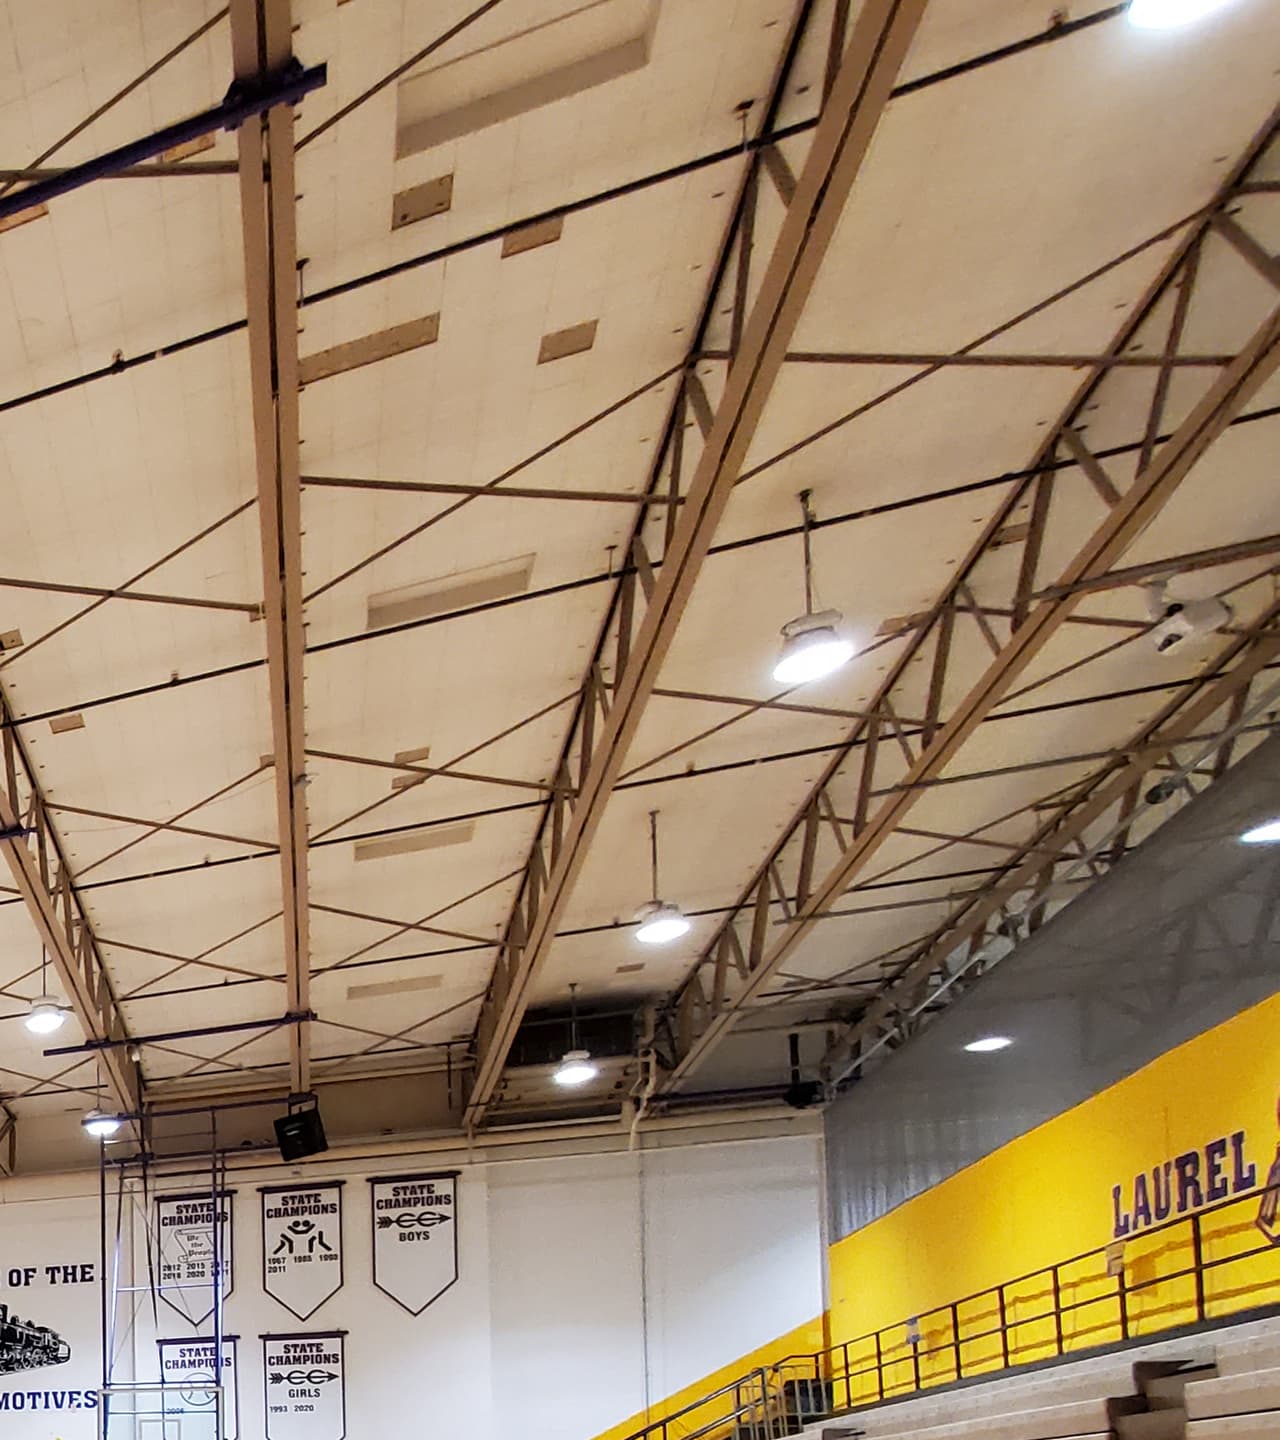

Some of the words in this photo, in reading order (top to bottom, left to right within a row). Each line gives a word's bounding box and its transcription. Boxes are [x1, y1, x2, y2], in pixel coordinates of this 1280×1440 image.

[392, 1184, 435, 1197] STATE
[1112, 1130, 1256, 1239] LAUREL
[281, 1193, 322, 1206] STATE
[376, 1194, 452, 1210] CHAMPIONS
[176, 1202, 214, 1214] STATE
[266, 1203, 338, 1218] CHAMPIONS
[399, 1231, 430, 1242] BOYS
[8, 1268, 37, 1287] OF
[45, 1264, 94, 1284] THE
[179, 1347, 216, 1358] STATE
[283, 1343, 323, 1354] STATE
[268, 1353, 339, 1366] CHAMPIONS
[288, 1388, 320, 1398] GIRLS
